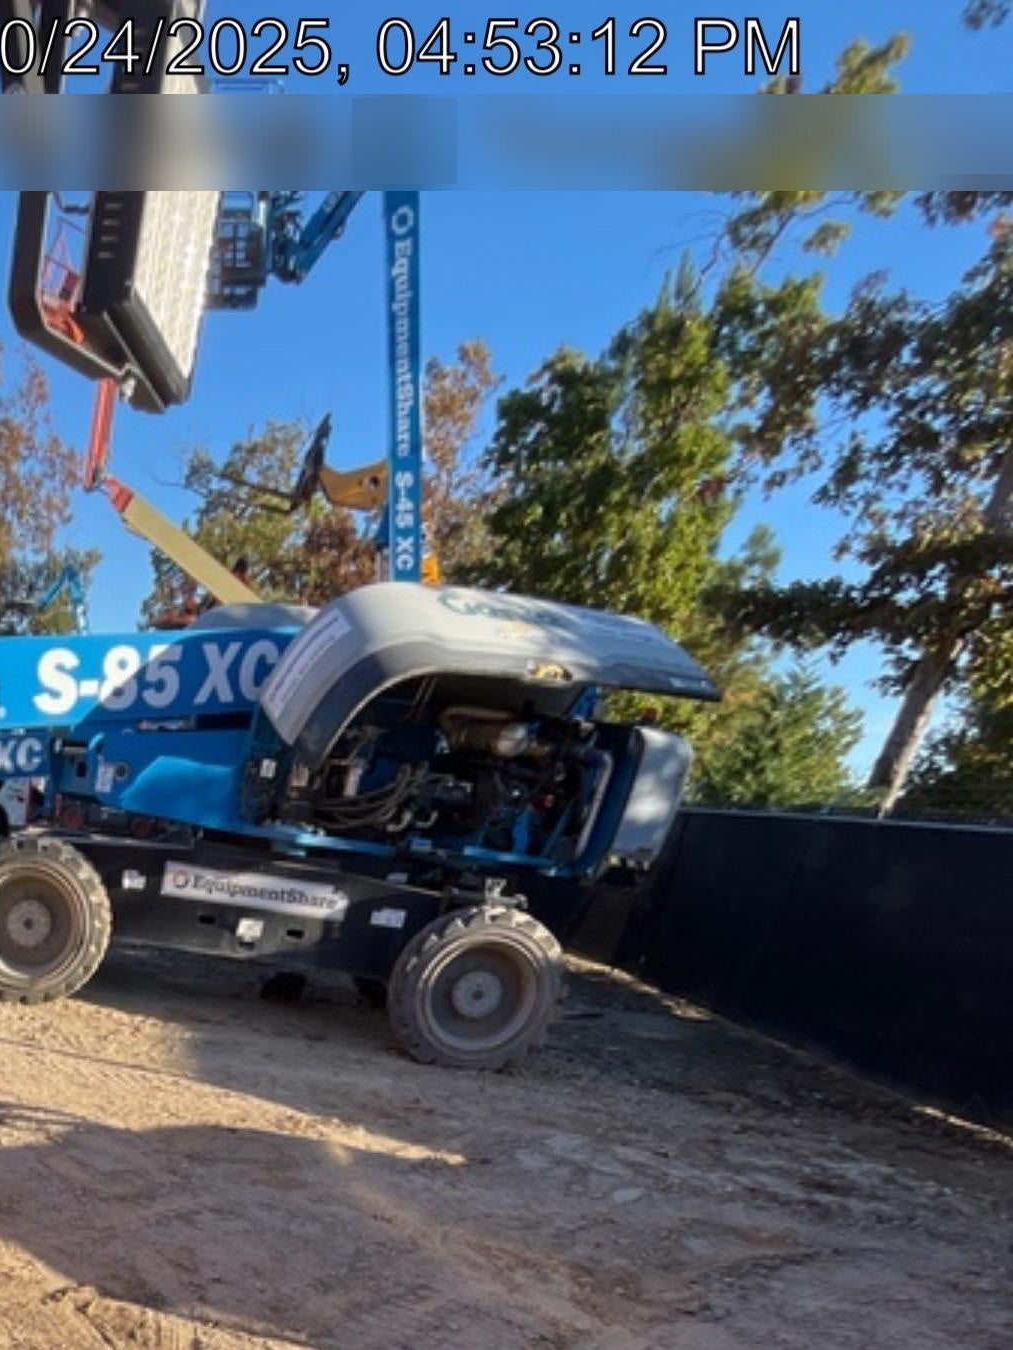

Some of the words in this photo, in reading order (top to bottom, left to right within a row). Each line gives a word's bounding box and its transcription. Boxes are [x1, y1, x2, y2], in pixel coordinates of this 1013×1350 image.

[392, 237, 413, 457] EquipmentShare
[395, 471, 414, 529] S-45
[396, 536, 414, 571] XC
[33, 645, 180, 715] S-85
[194, 640, 280, 703] XC
[192, 874, 335, 910] EquipmentShare
